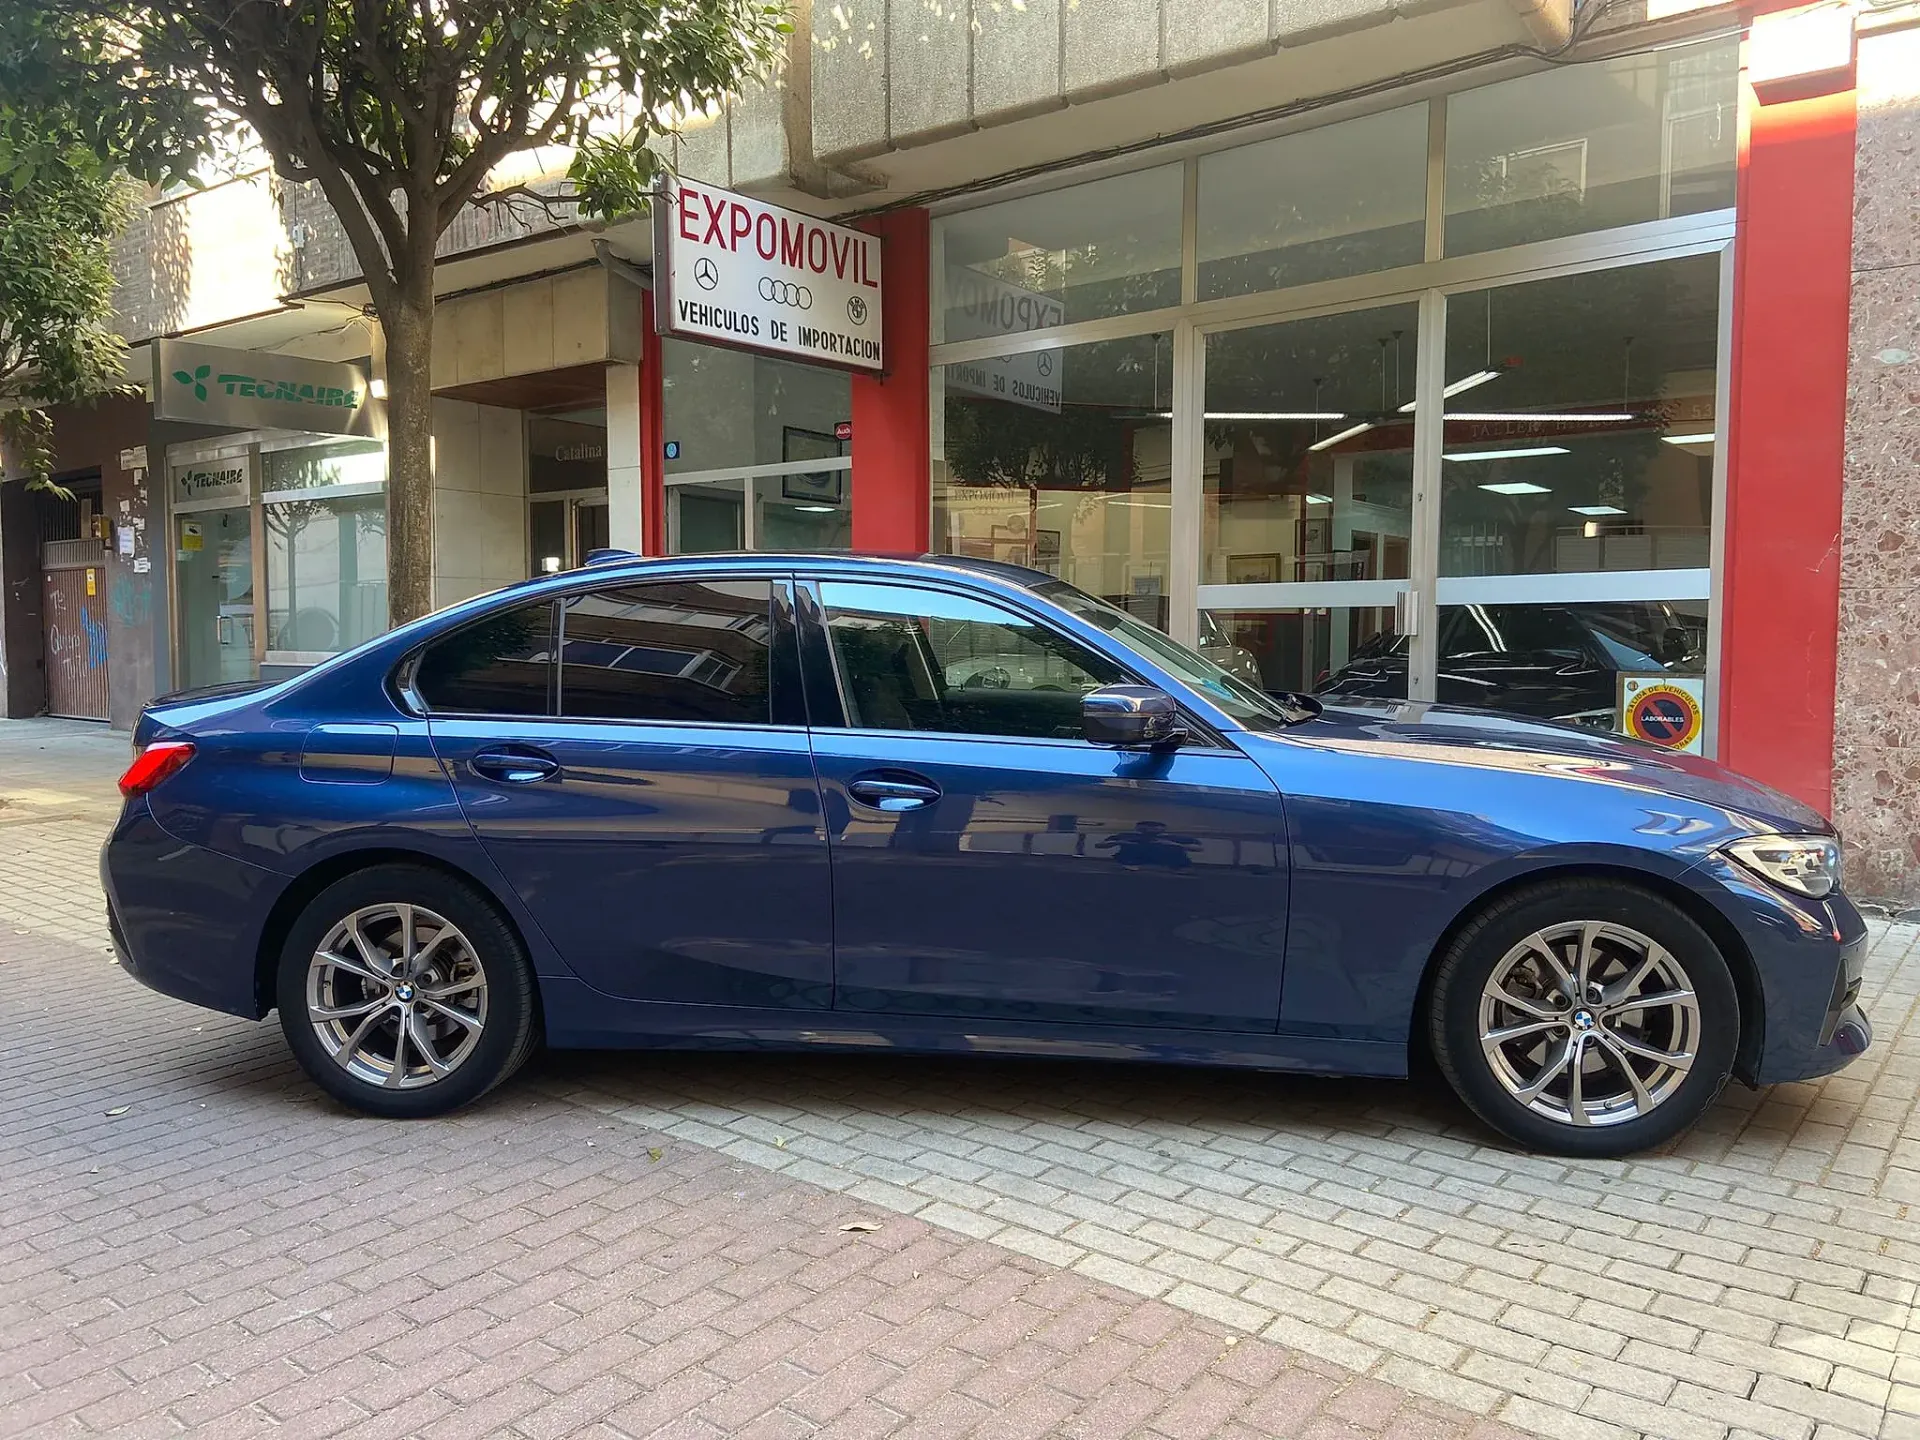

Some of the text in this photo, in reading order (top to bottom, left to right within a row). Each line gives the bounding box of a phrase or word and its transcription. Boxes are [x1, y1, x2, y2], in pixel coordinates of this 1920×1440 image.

[679, 187, 878, 288] EXPOMOVIL
[678, 299, 881, 361] VEHICULOS DE IMPORTACION
[217, 374, 358, 409] TECNAIRE
[555, 443, 602, 462] Catalina
[193, 468, 243, 488] TECNAIRE
[1627, 685, 1700, 715] SALIDA DE VEHICULOS
[1641, 715, 1684, 723] LABORABLES
